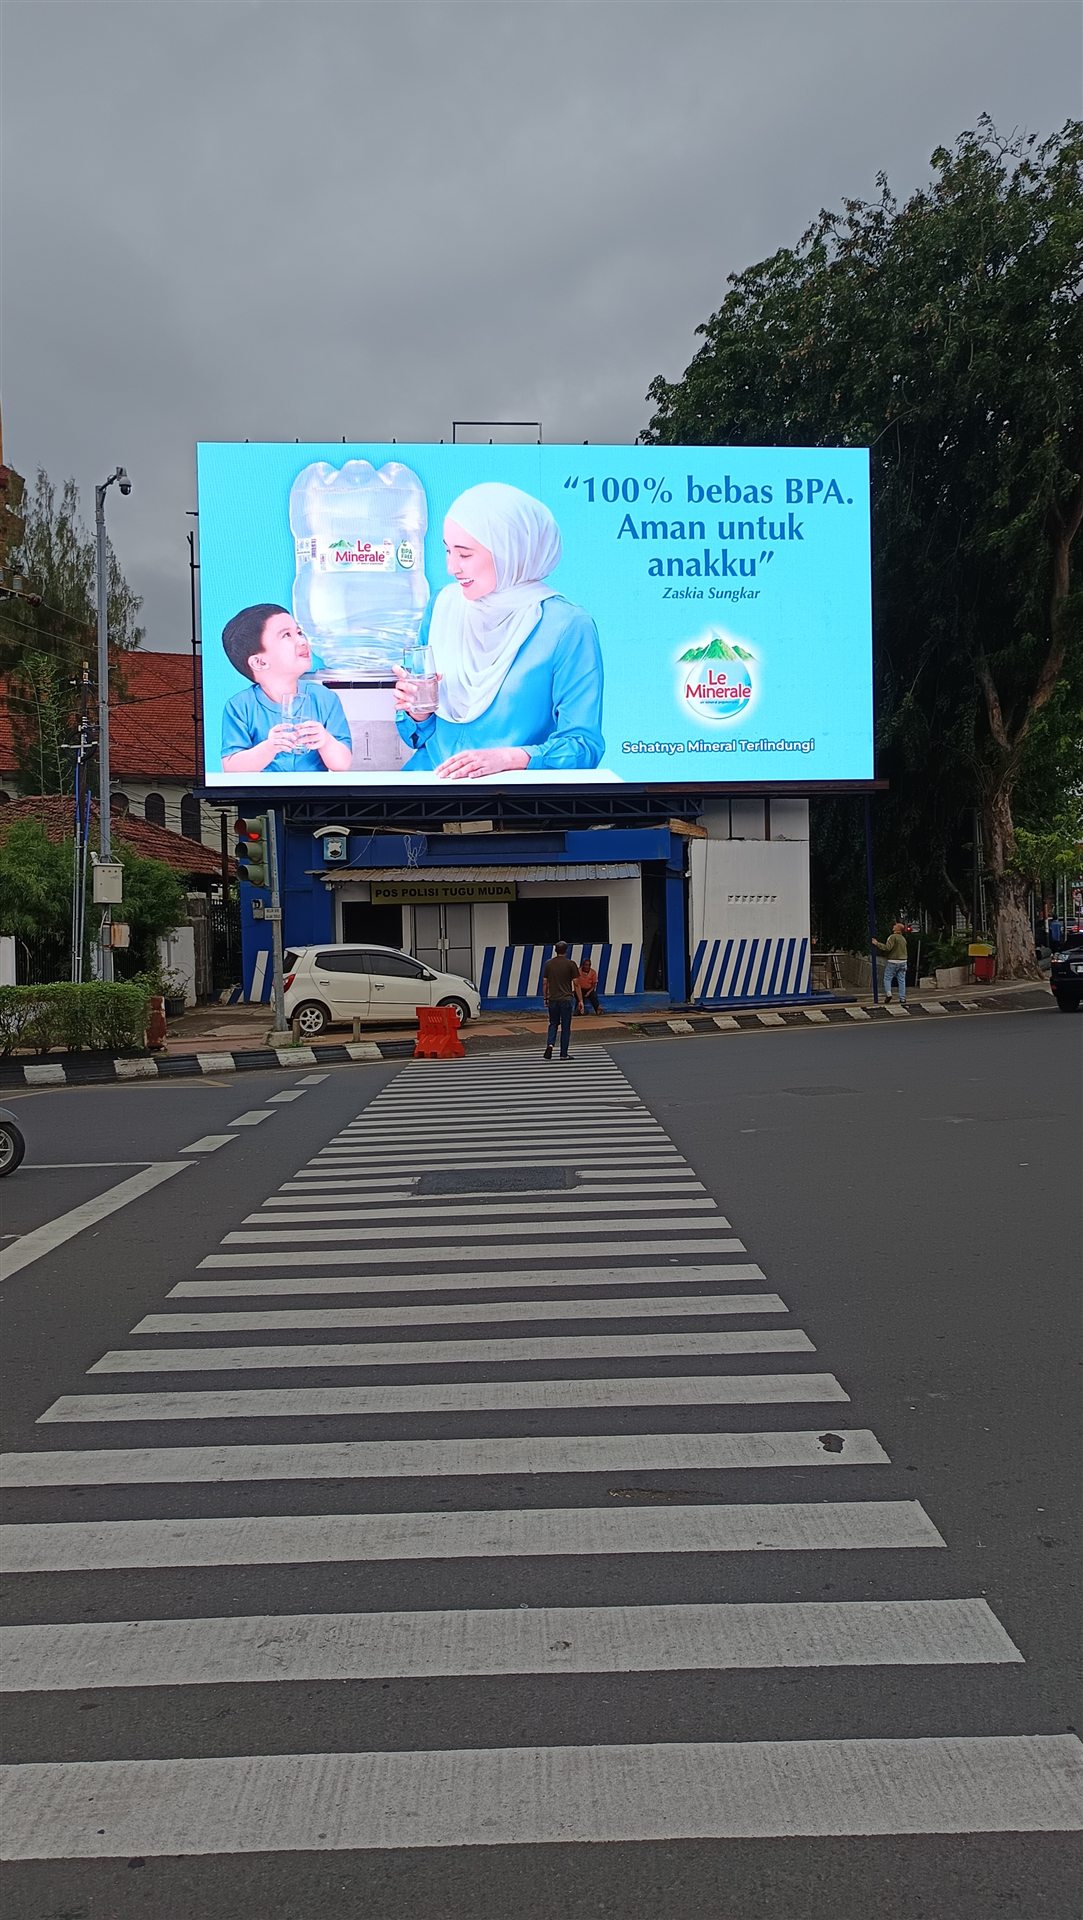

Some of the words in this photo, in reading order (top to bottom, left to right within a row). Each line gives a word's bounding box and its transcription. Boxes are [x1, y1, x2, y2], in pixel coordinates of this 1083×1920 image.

[687, 475, 774, 503] bebas
[785, 478, 854, 505] BPA.
[616, 513, 706, 540] Aman
[718, 512, 805, 541] untuk
[357, 540, 371, 552] Le
[335, 551, 385, 563] Minerale
[661, 586, 704, 600] Zaskia
[707, 586, 761, 603] Sungkar
[708, 669, 727, 686] Le
[685, 683, 751, 699] Minerale
[622, 741, 684, 755] Sehatnya
[687, 739, 736, 752] Mineral
[739, 737, 815, 754] Terlindungi
[375, 889, 398, 898] POS
[401, 888, 439, 897] POLISI
[442, 887, 474, 896] TUGU
[478, 886, 511, 896] MUDA
